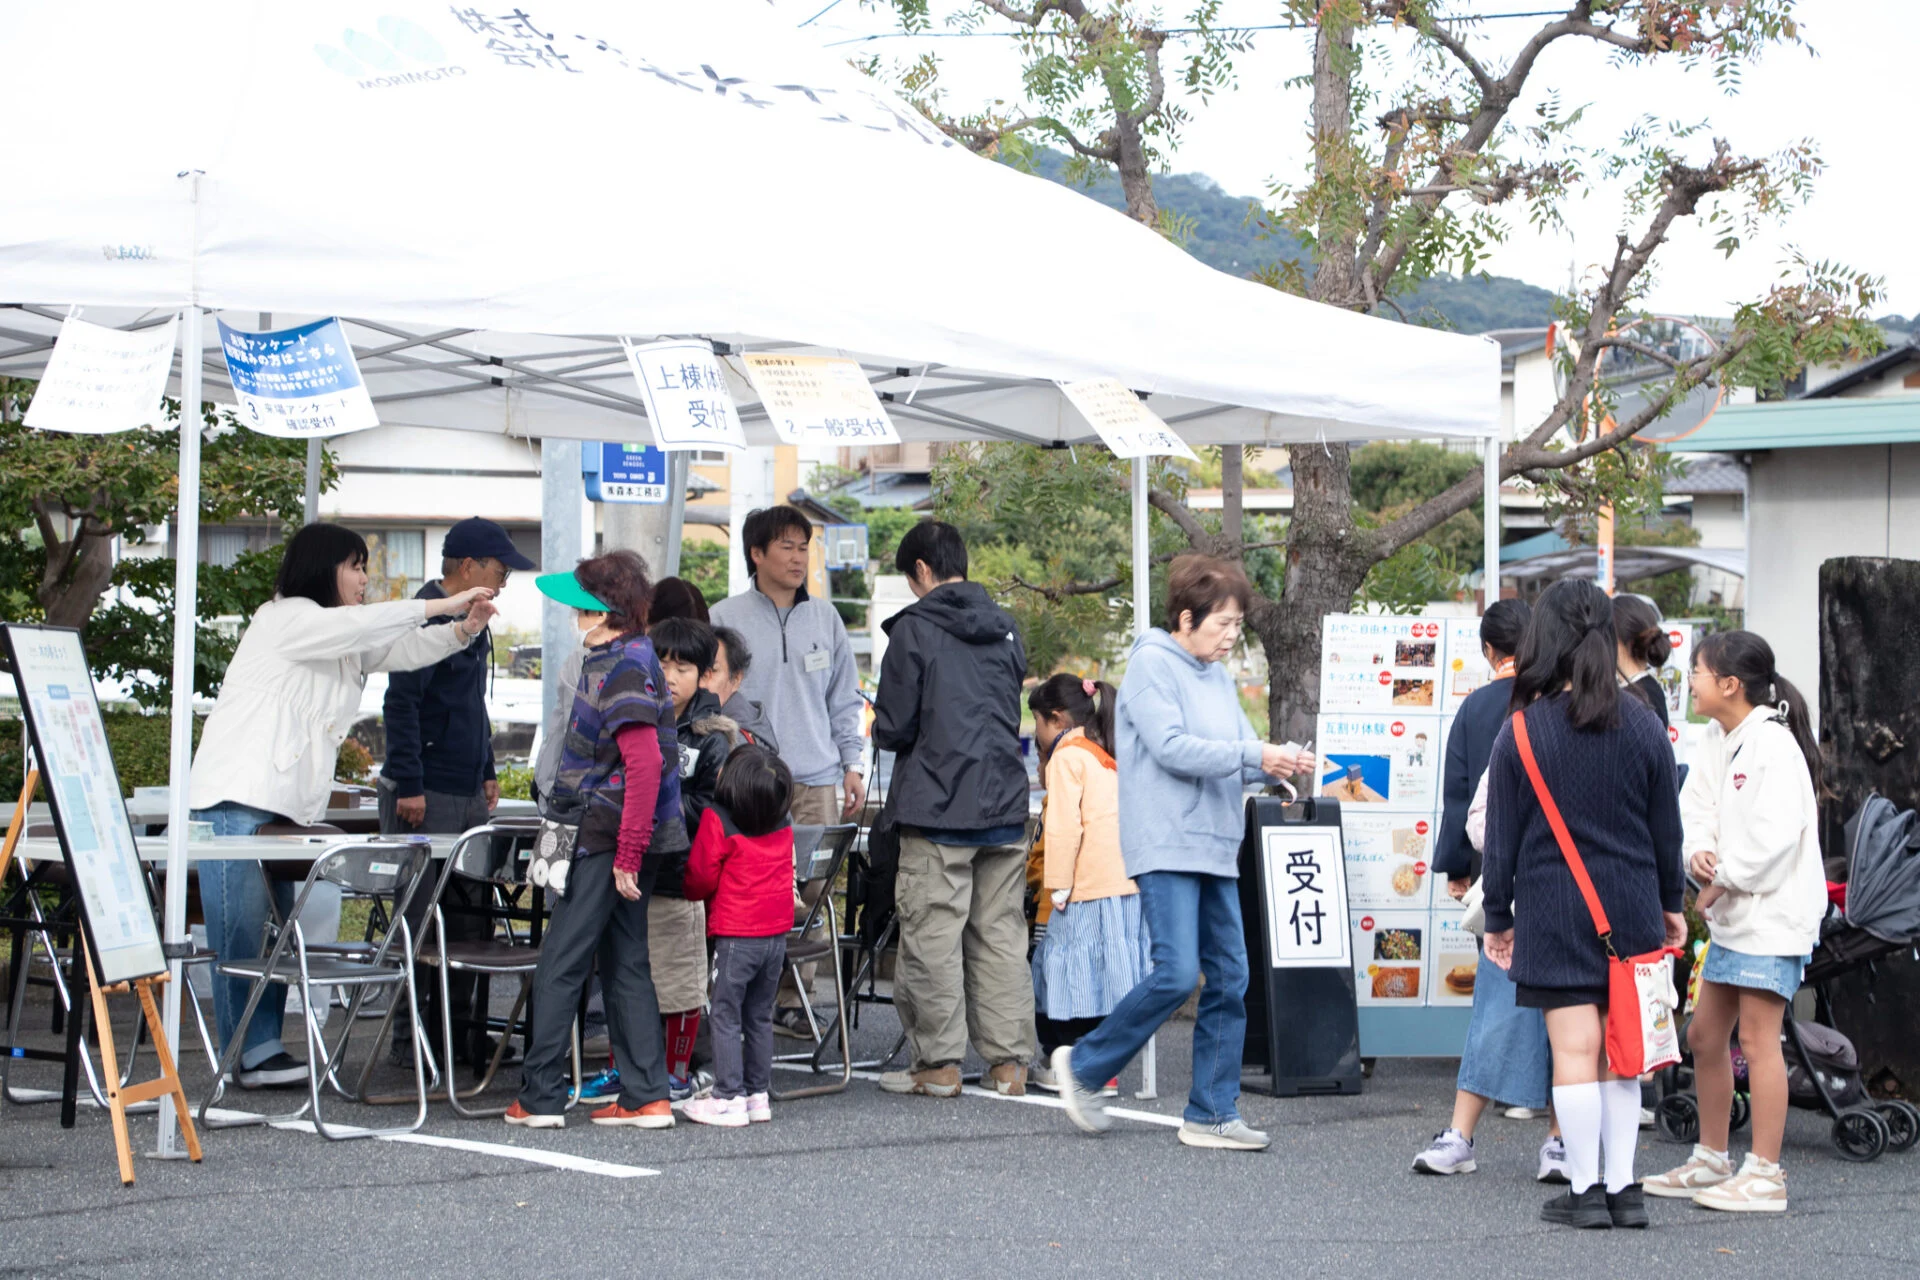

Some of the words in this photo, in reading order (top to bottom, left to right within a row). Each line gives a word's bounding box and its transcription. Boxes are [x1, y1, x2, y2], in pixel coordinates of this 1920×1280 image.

[448, 4, 555, 41] 株式
[484, 37, 584, 74] 会社
[357, 64, 468, 90] MORIMOTO
[264, 399, 350, 416] 来場アンケート
[688, 400, 728, 431] 受付
[285, 415, 336, 431] 確認受付
[1330, 623, 1409, 636] おやこ自由木工作
[1328, 672, 1376, 683] キッズ木工
[1325, 721, 1386, 736] 瓦割り体験
[1286, 849, 1327, 946] 受付
